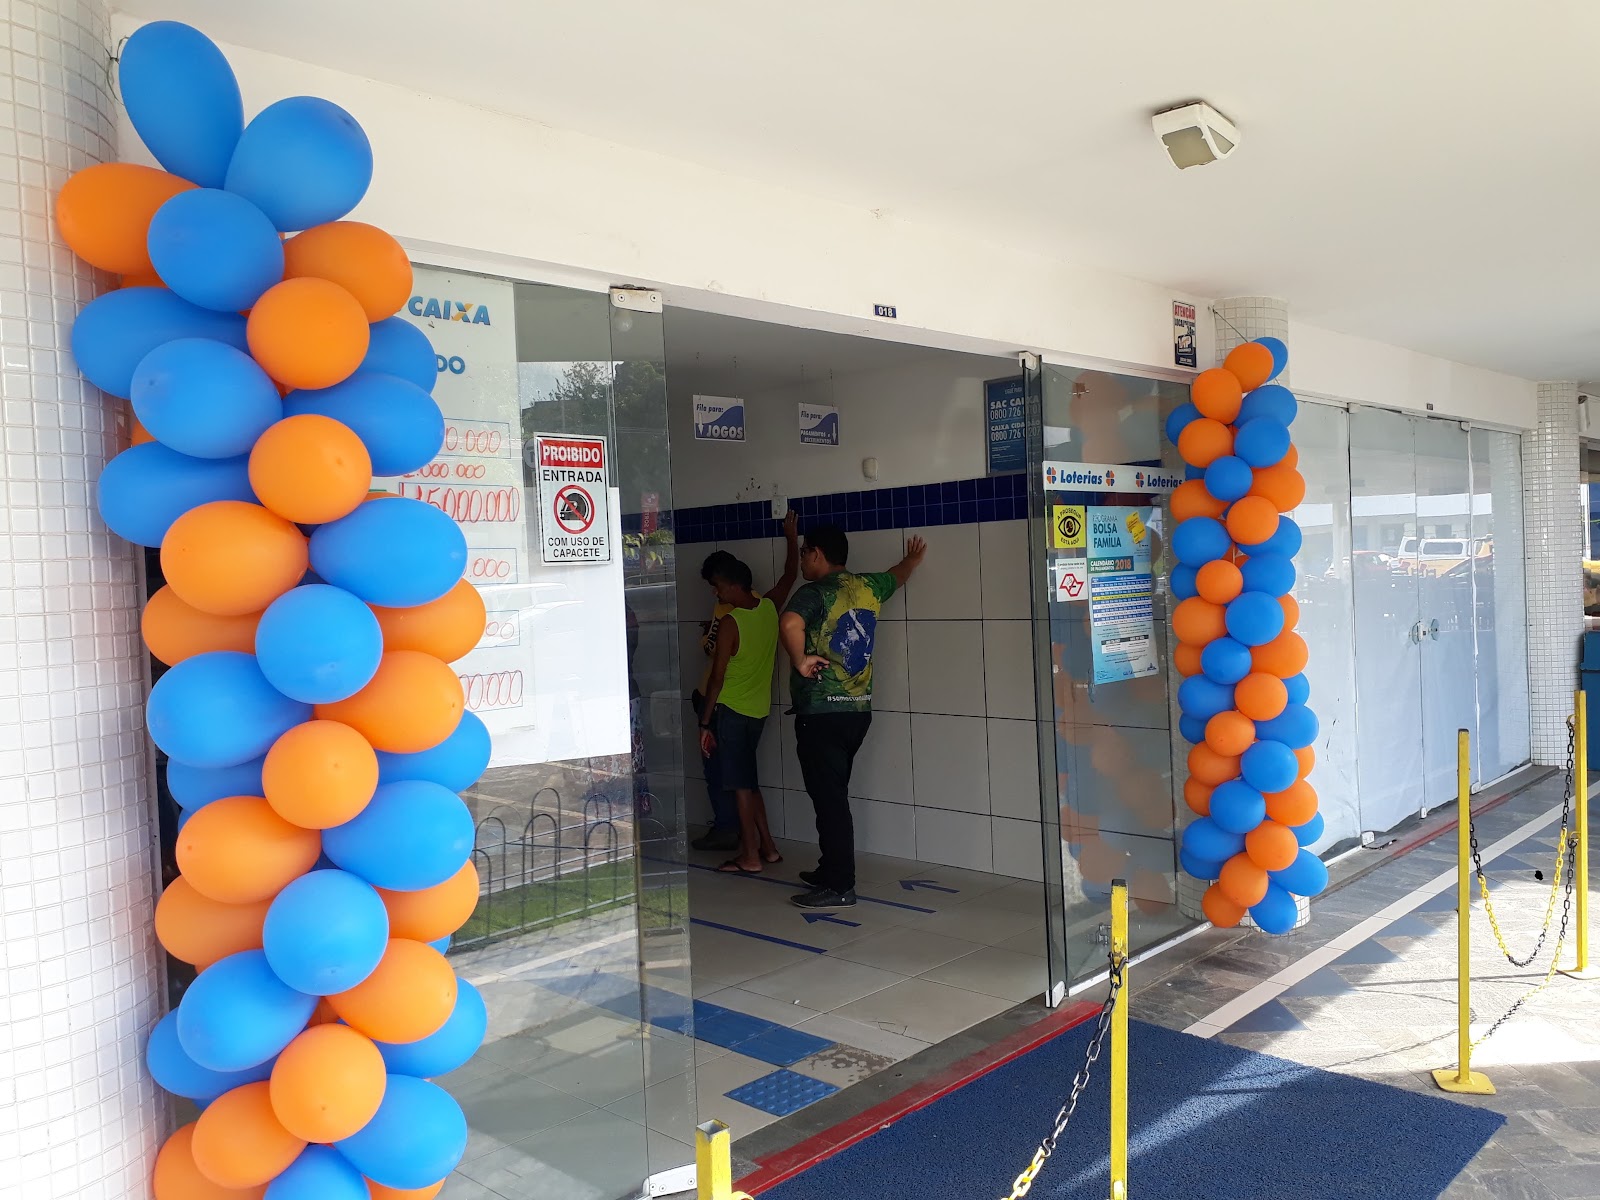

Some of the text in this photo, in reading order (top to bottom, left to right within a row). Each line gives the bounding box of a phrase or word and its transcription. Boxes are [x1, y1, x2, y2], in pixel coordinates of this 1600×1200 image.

[408, 296, 491, 326] CAIXA
[696, 403, 724, 413] Fila para:
[990, 399, 1007, 410] SAC
[800, 410, 809, 419] Fila
[990, 408, 1007, 420] 0800
[1008, 406, 1021, 418] 726
[706, 424, 744, 439] JOGOS
[991, 424, 1010, 432] CAIXA
[991, 430, 1008, 441] 0800
[1009, 428, 1021, 439] 726
[542, 445, 601, 463] PROIBIDO
[543, 469, 603, 483] ENTRADA
[1060, 469, 1103, 486] Loterias
[1093, 523, 1118, 534] BOLSA
[548, 536, 605, 547] COM USO DE
[1093, 534, 1122, 548] FAMÍLIA
[553, 547, 600, 558] CAPACETE
[1090, 558, 1115, 567] CALENDÁRIO
[1115, 559, 1132, 570] 2018
